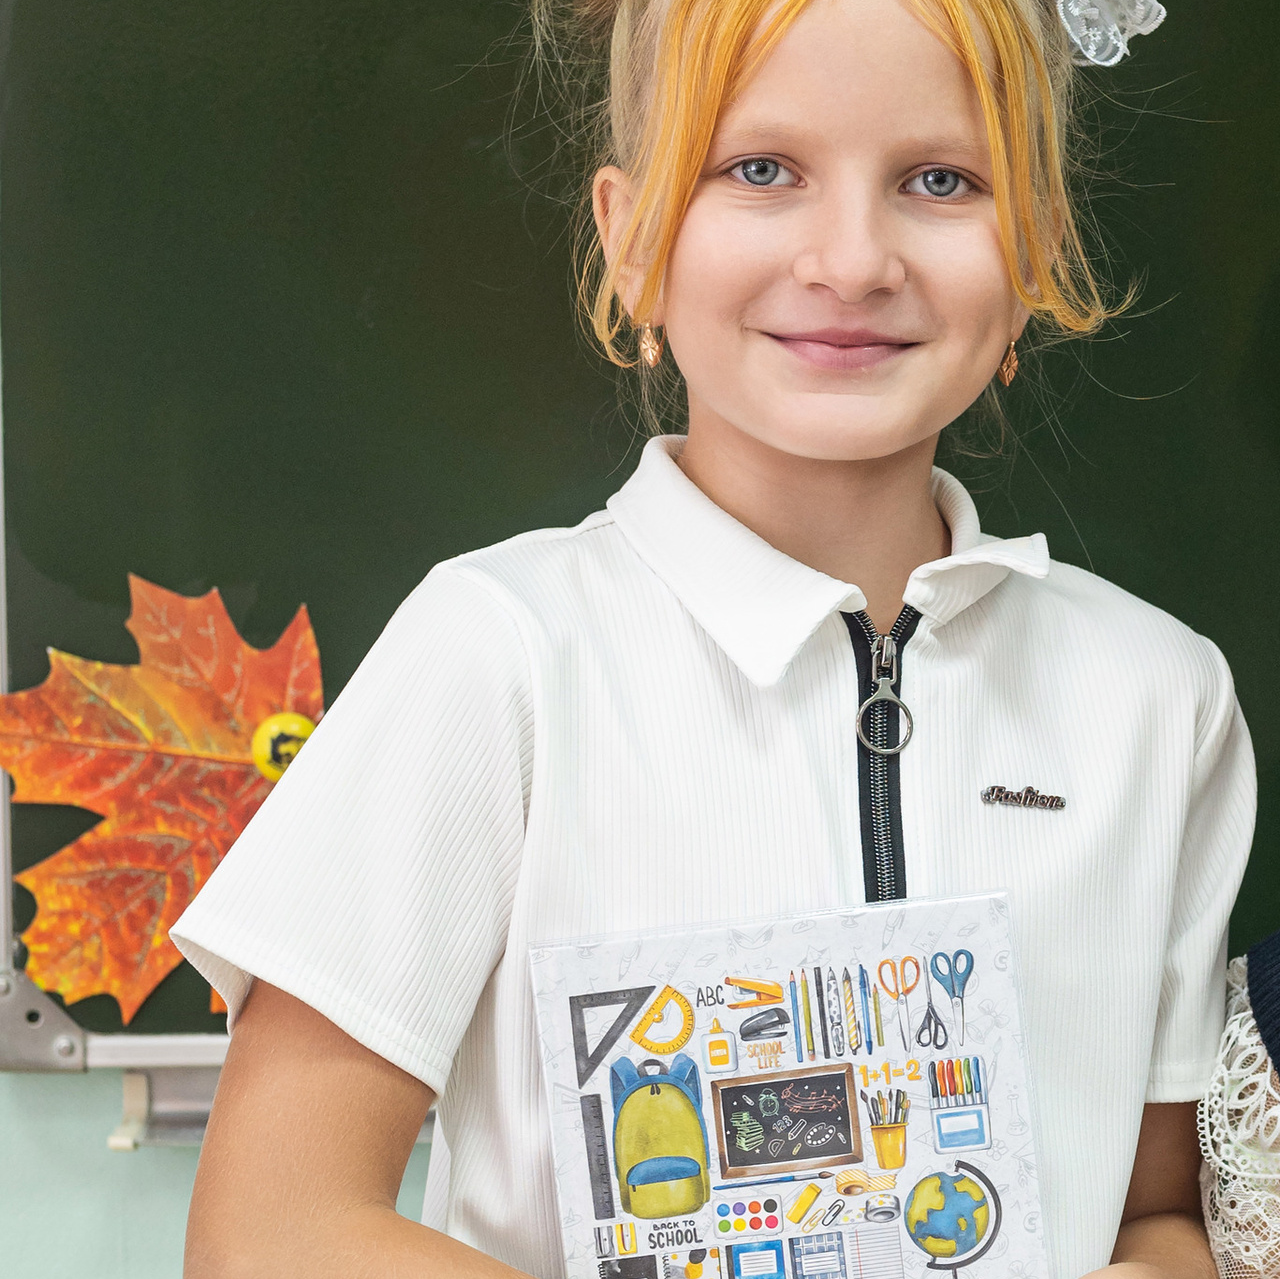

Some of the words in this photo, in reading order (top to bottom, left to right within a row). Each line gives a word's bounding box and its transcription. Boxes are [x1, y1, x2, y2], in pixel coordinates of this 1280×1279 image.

[982, 785, 1067, 810] Fashion
[696, 984, 724, 1008] ABC
[747, 1041, 786, 1058] SCHOOL
[757, 1055, 782, 1070] LIFE
[858, 1059, 922, 1087] 1+1=2
[772, 1115, 793, 1134] 123
[653, 1221, 679, 1231] BACK
[682, 1219, 695, 1227] TO
[648, 1227, 703, 1250] SCHOOL
